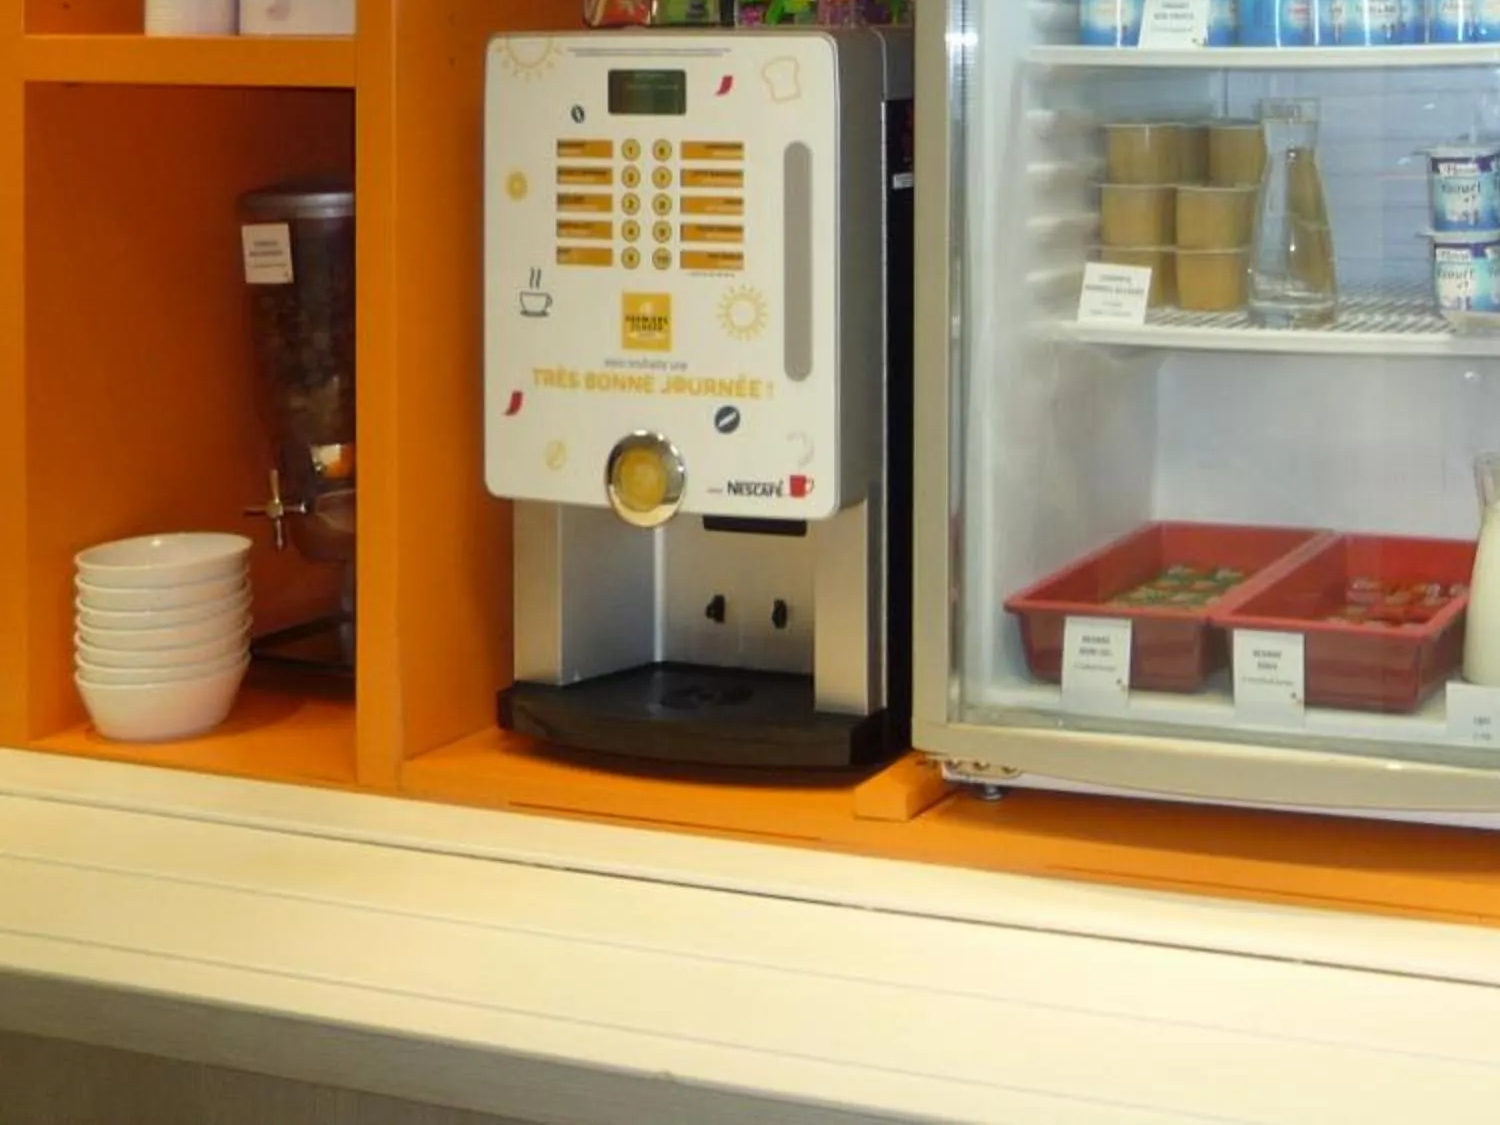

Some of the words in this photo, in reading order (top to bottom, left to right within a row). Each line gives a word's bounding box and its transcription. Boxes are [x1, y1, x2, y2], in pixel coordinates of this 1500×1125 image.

[532, 364, 580, 389] TRÈS
[584, 371, 655, 394] BONNE
[659, 373, 763, 398] JOURNÉE
[727, 479, 784, 499] NESCAFÉ
